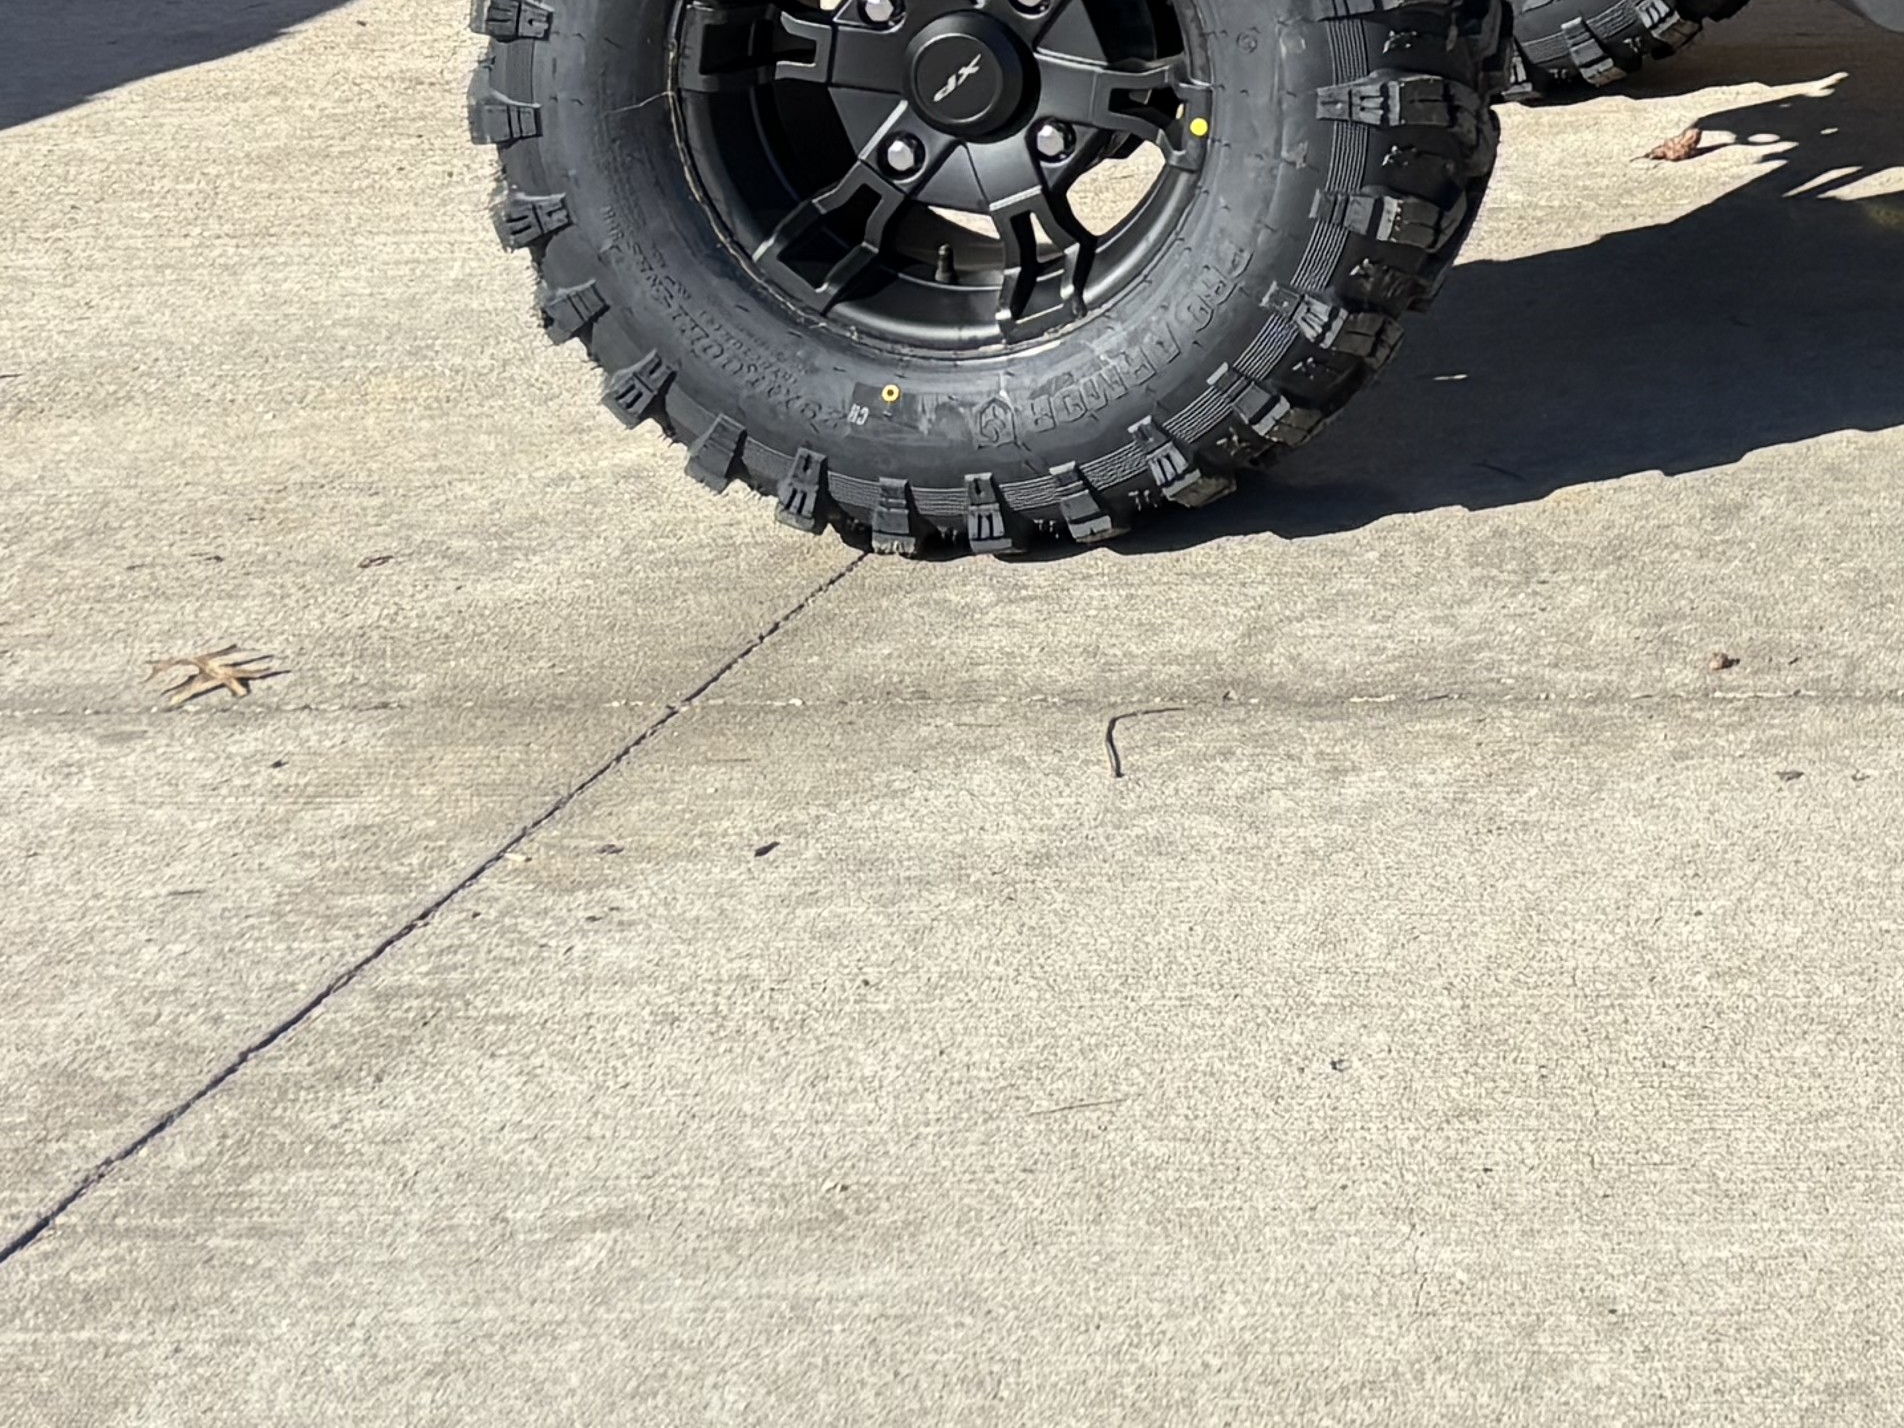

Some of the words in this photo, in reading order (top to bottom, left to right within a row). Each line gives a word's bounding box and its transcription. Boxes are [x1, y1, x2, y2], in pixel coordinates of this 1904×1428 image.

[933, 53, 981, 102] XP
[1175, 246, 1254, 333] PRO
[1028, 323, 1182, 433] ARMOR
